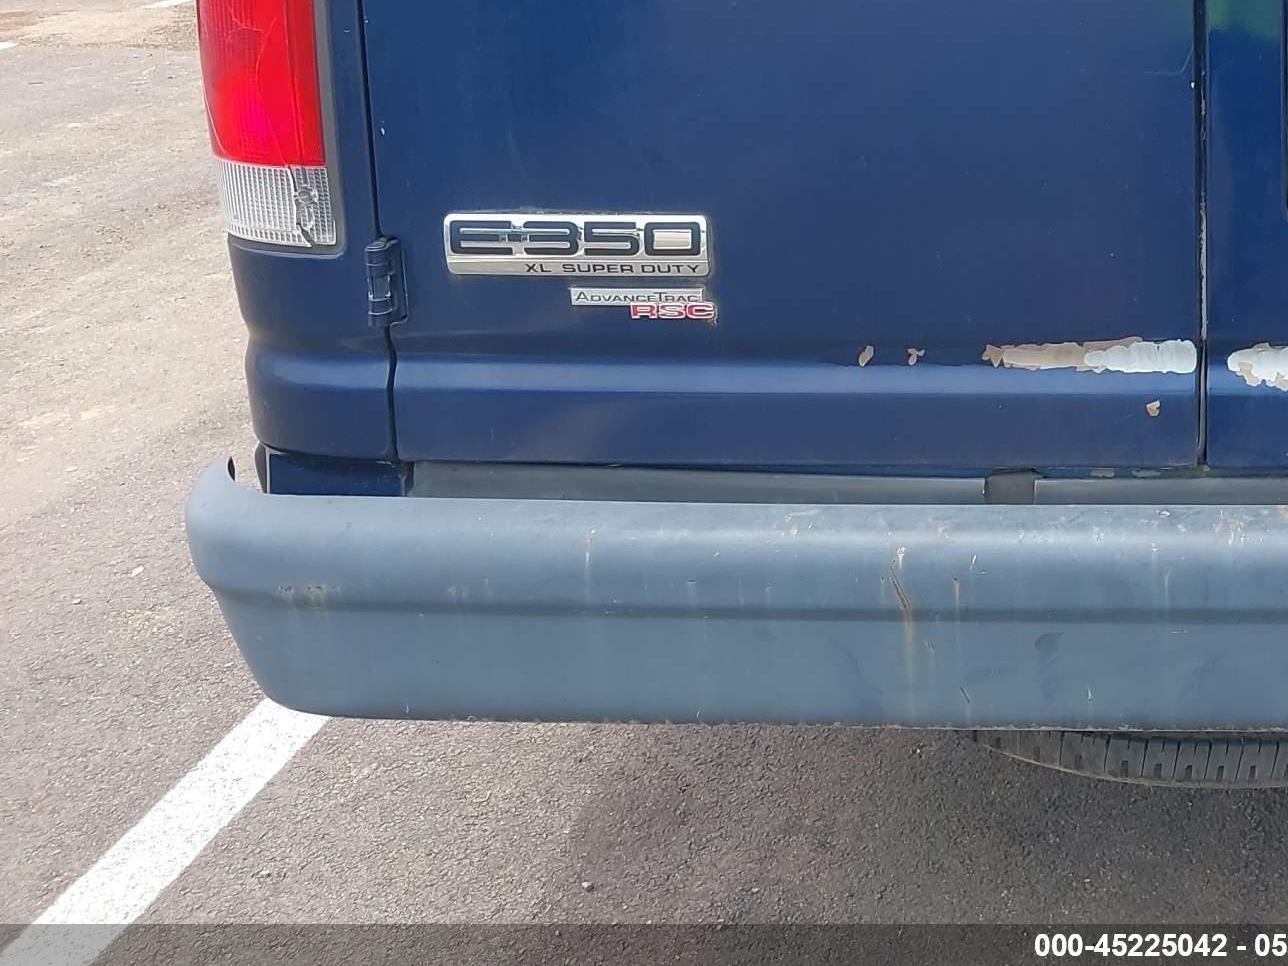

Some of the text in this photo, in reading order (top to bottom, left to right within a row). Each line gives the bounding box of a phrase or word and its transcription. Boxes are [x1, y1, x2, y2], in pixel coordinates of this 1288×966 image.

[525, 263, 701, 274] XL SUPER DUTY
[630, 302, 715, 319] RSC
